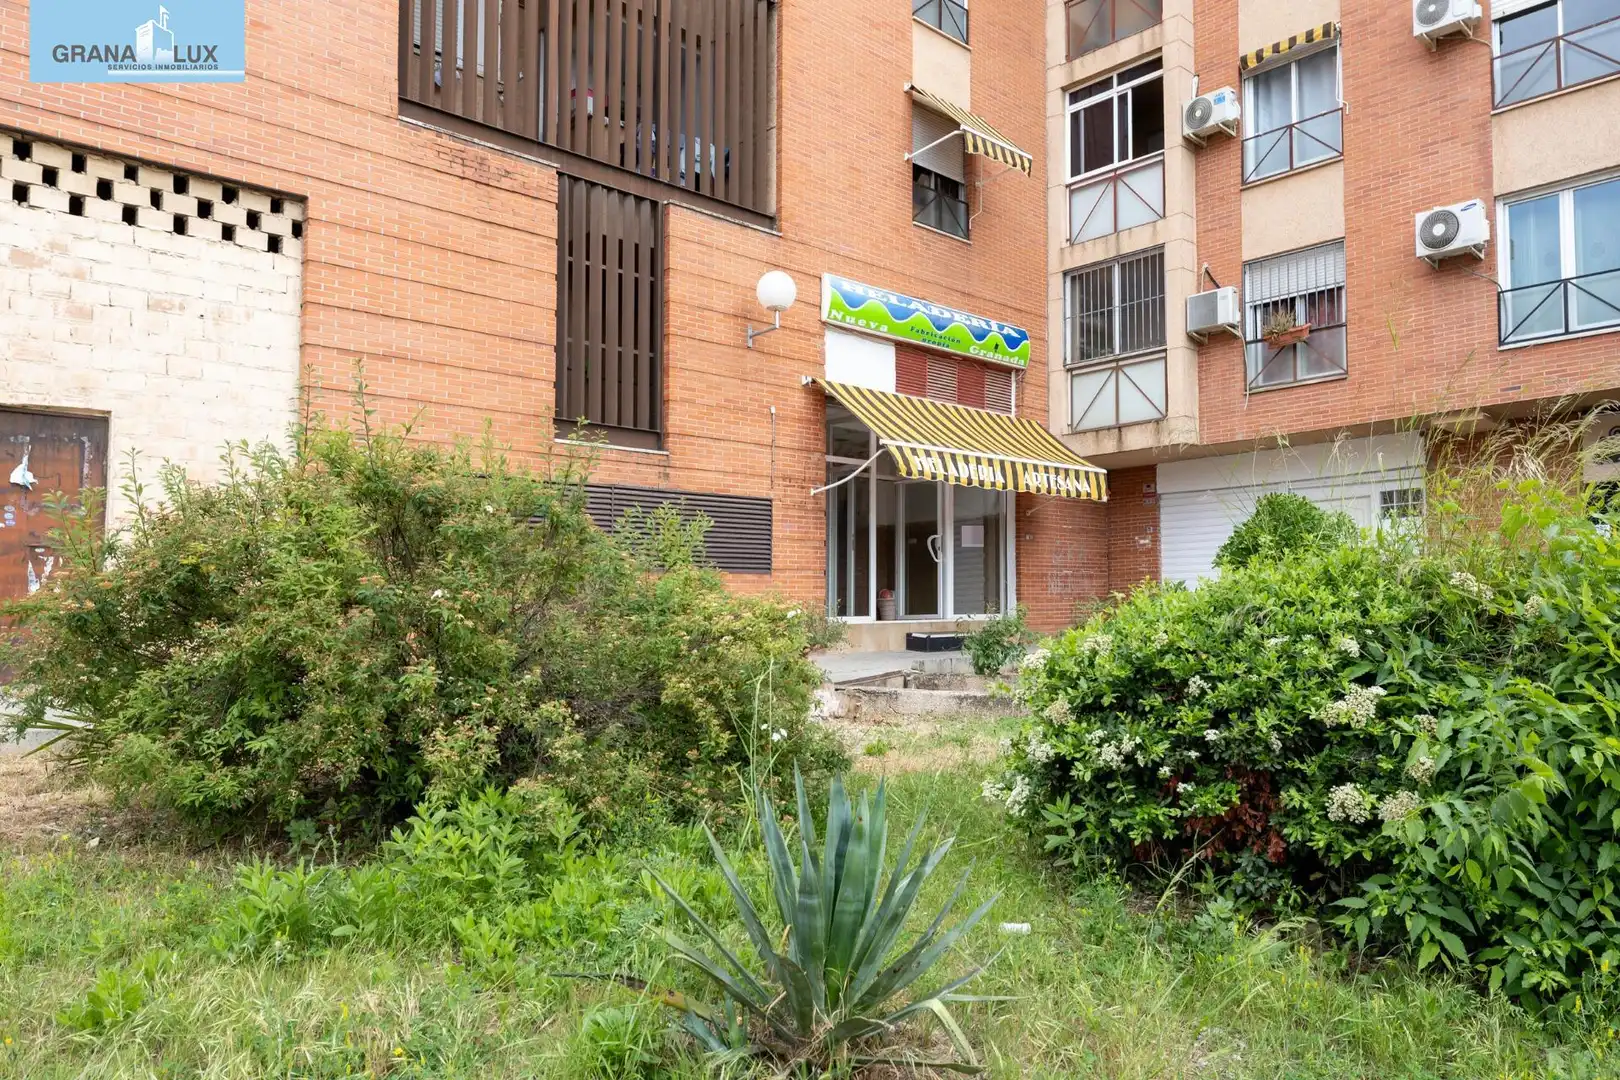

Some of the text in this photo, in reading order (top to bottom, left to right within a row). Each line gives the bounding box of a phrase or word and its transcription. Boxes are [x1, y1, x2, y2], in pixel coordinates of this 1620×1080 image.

[829, 309, 1025, 366] Nueva Granada
[913, 454, 1092, 493] HELADERIA ARTESANA
